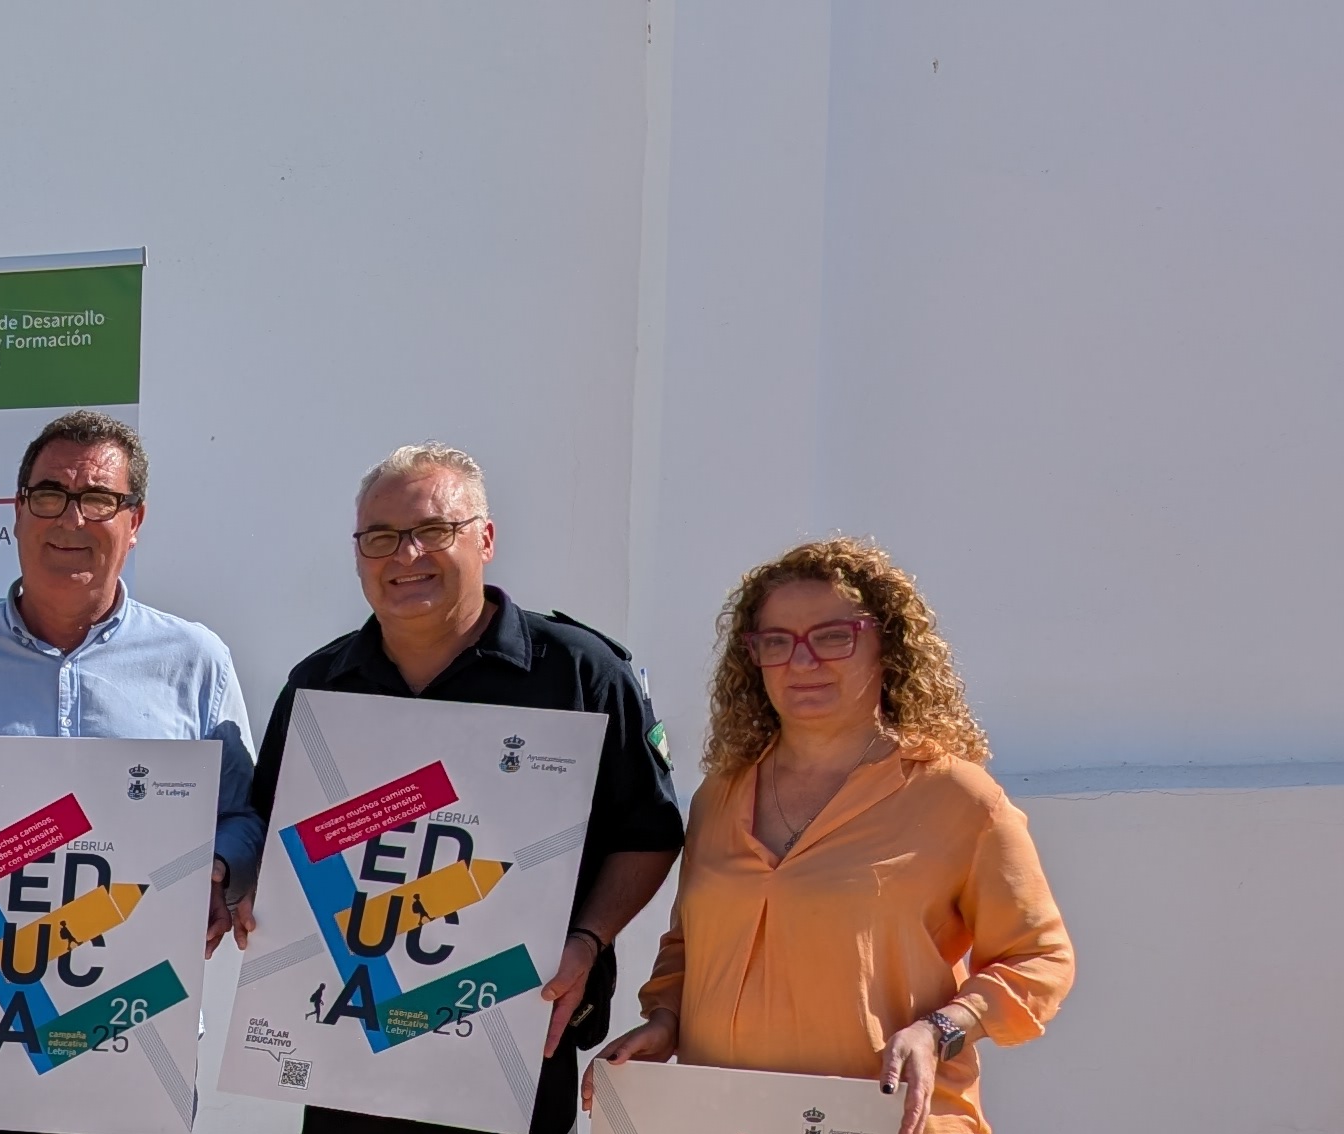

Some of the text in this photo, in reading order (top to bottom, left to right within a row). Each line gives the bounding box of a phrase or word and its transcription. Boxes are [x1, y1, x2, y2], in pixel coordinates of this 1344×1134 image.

[22, 310, 105, 330] Desarrollo
[5, 330, 92, 350] Formación
[428, 811, 480, 826] LEBRIJA
[66, 840, 115, 852] LEBRIJA
[322, 963, 380, 1032] A
[455, 979, 498, 1010] 26
[109, 998, 148, 1026] 26
[433, 1006, 473, 1037] 25
[92, 1025, 129, 1052] 25
